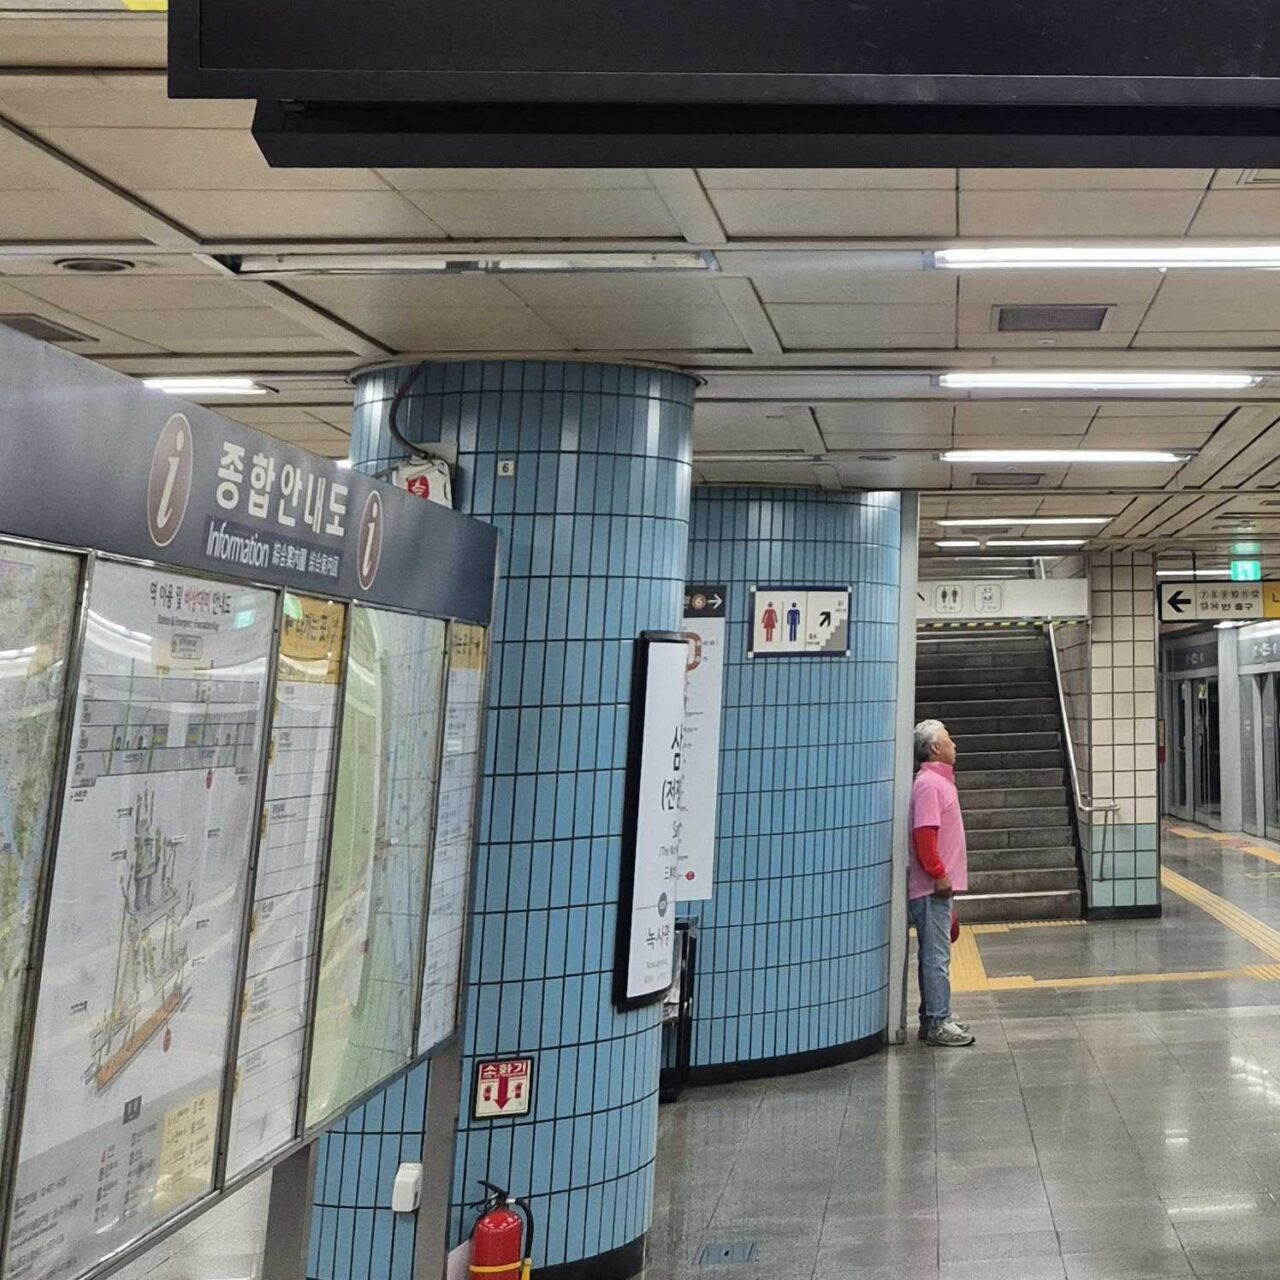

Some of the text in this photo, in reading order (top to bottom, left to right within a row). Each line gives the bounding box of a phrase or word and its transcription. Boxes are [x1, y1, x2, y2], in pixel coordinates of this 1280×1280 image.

[502, 462, 510, 474] 6
[215, 441, 349, 536] 종합안내도
[206, 520, 270, 569] Information
[483, 1061, 527, 1074] 소화기
